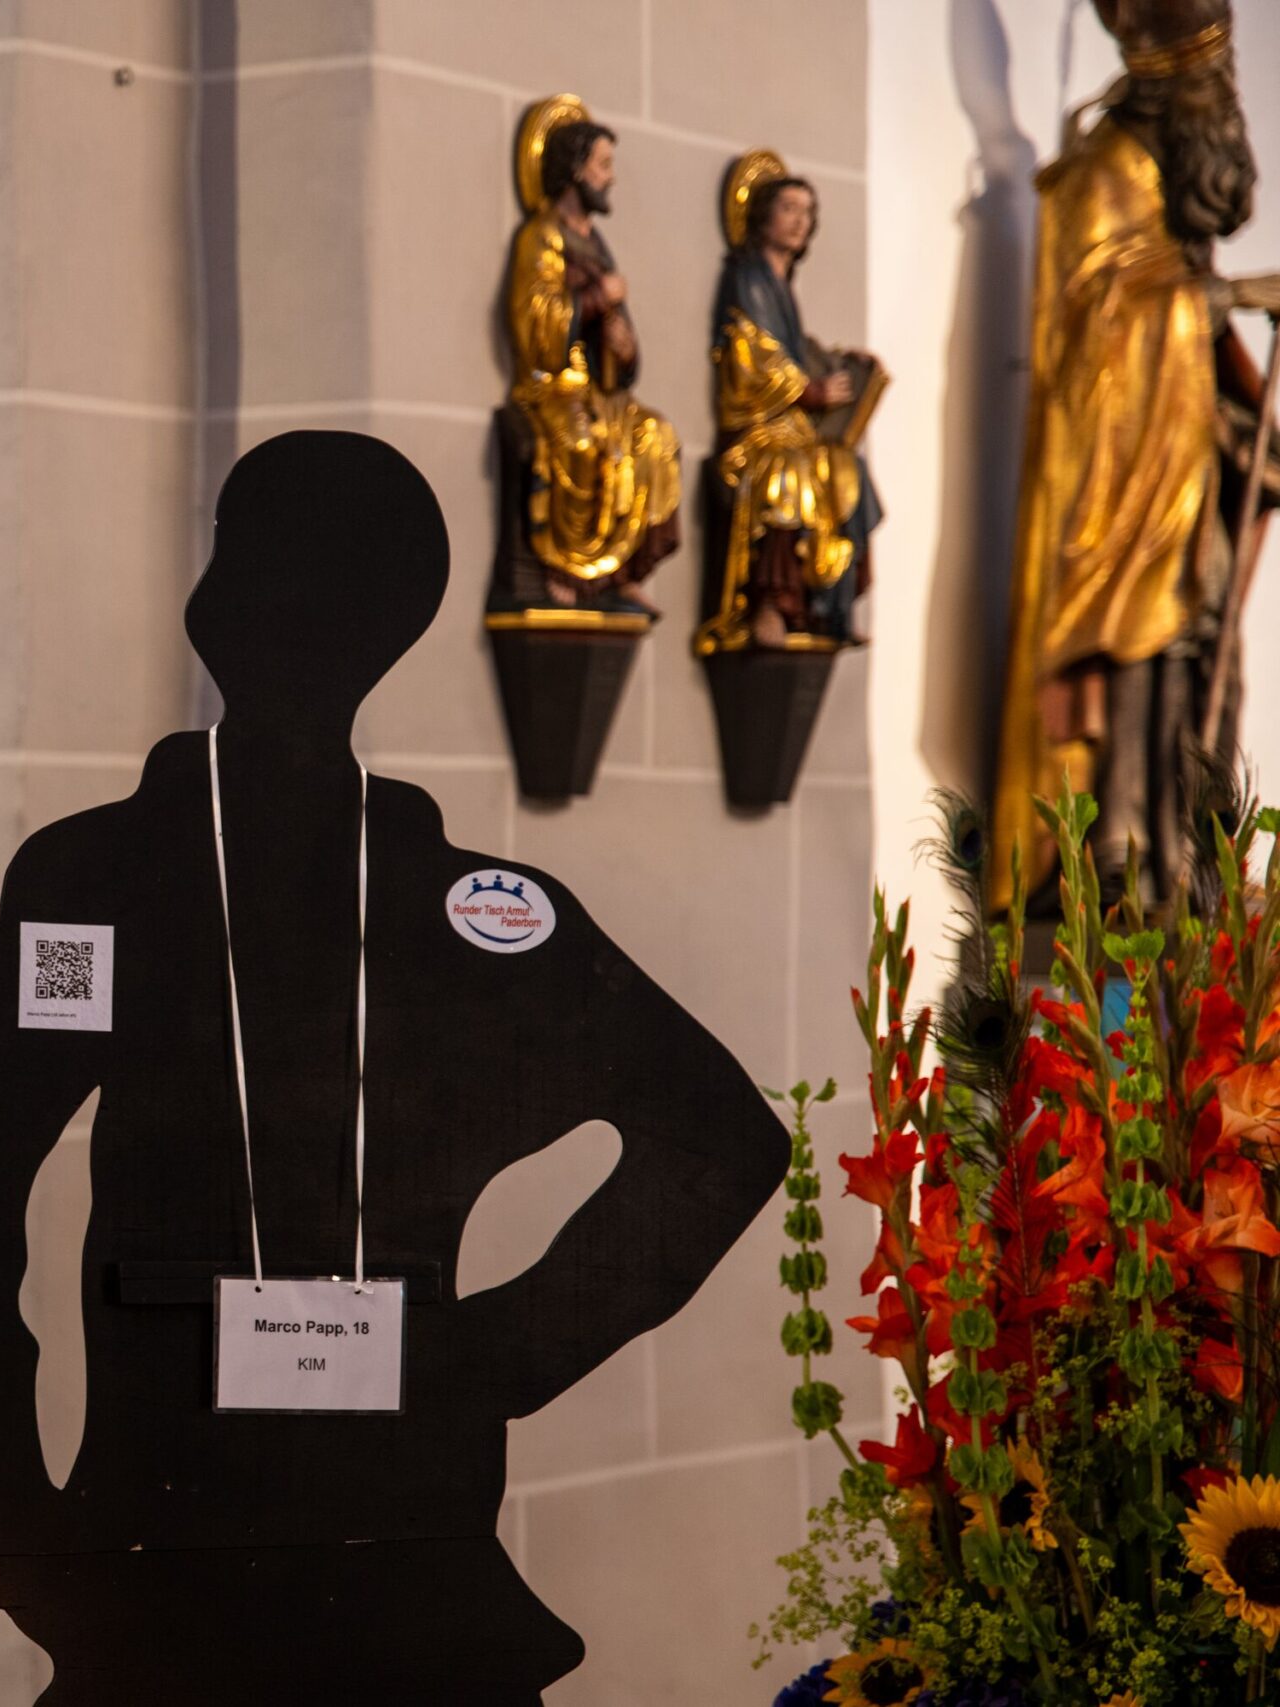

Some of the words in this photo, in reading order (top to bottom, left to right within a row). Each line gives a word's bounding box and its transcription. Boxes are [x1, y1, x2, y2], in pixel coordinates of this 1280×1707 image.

[453, 904, 481, 914] Runder
[484, 905, 505, 915] Tisch
[506, 906, 530, 916] Armut
[500, 917, 542, 928] Paderborn
[254, 1319, 301, 1333] Marco
[306, 1320, 348, 1336] Papp,
[353, 1322, 370, 1335] 18
[297, 1358, 326, 1371] KIM
